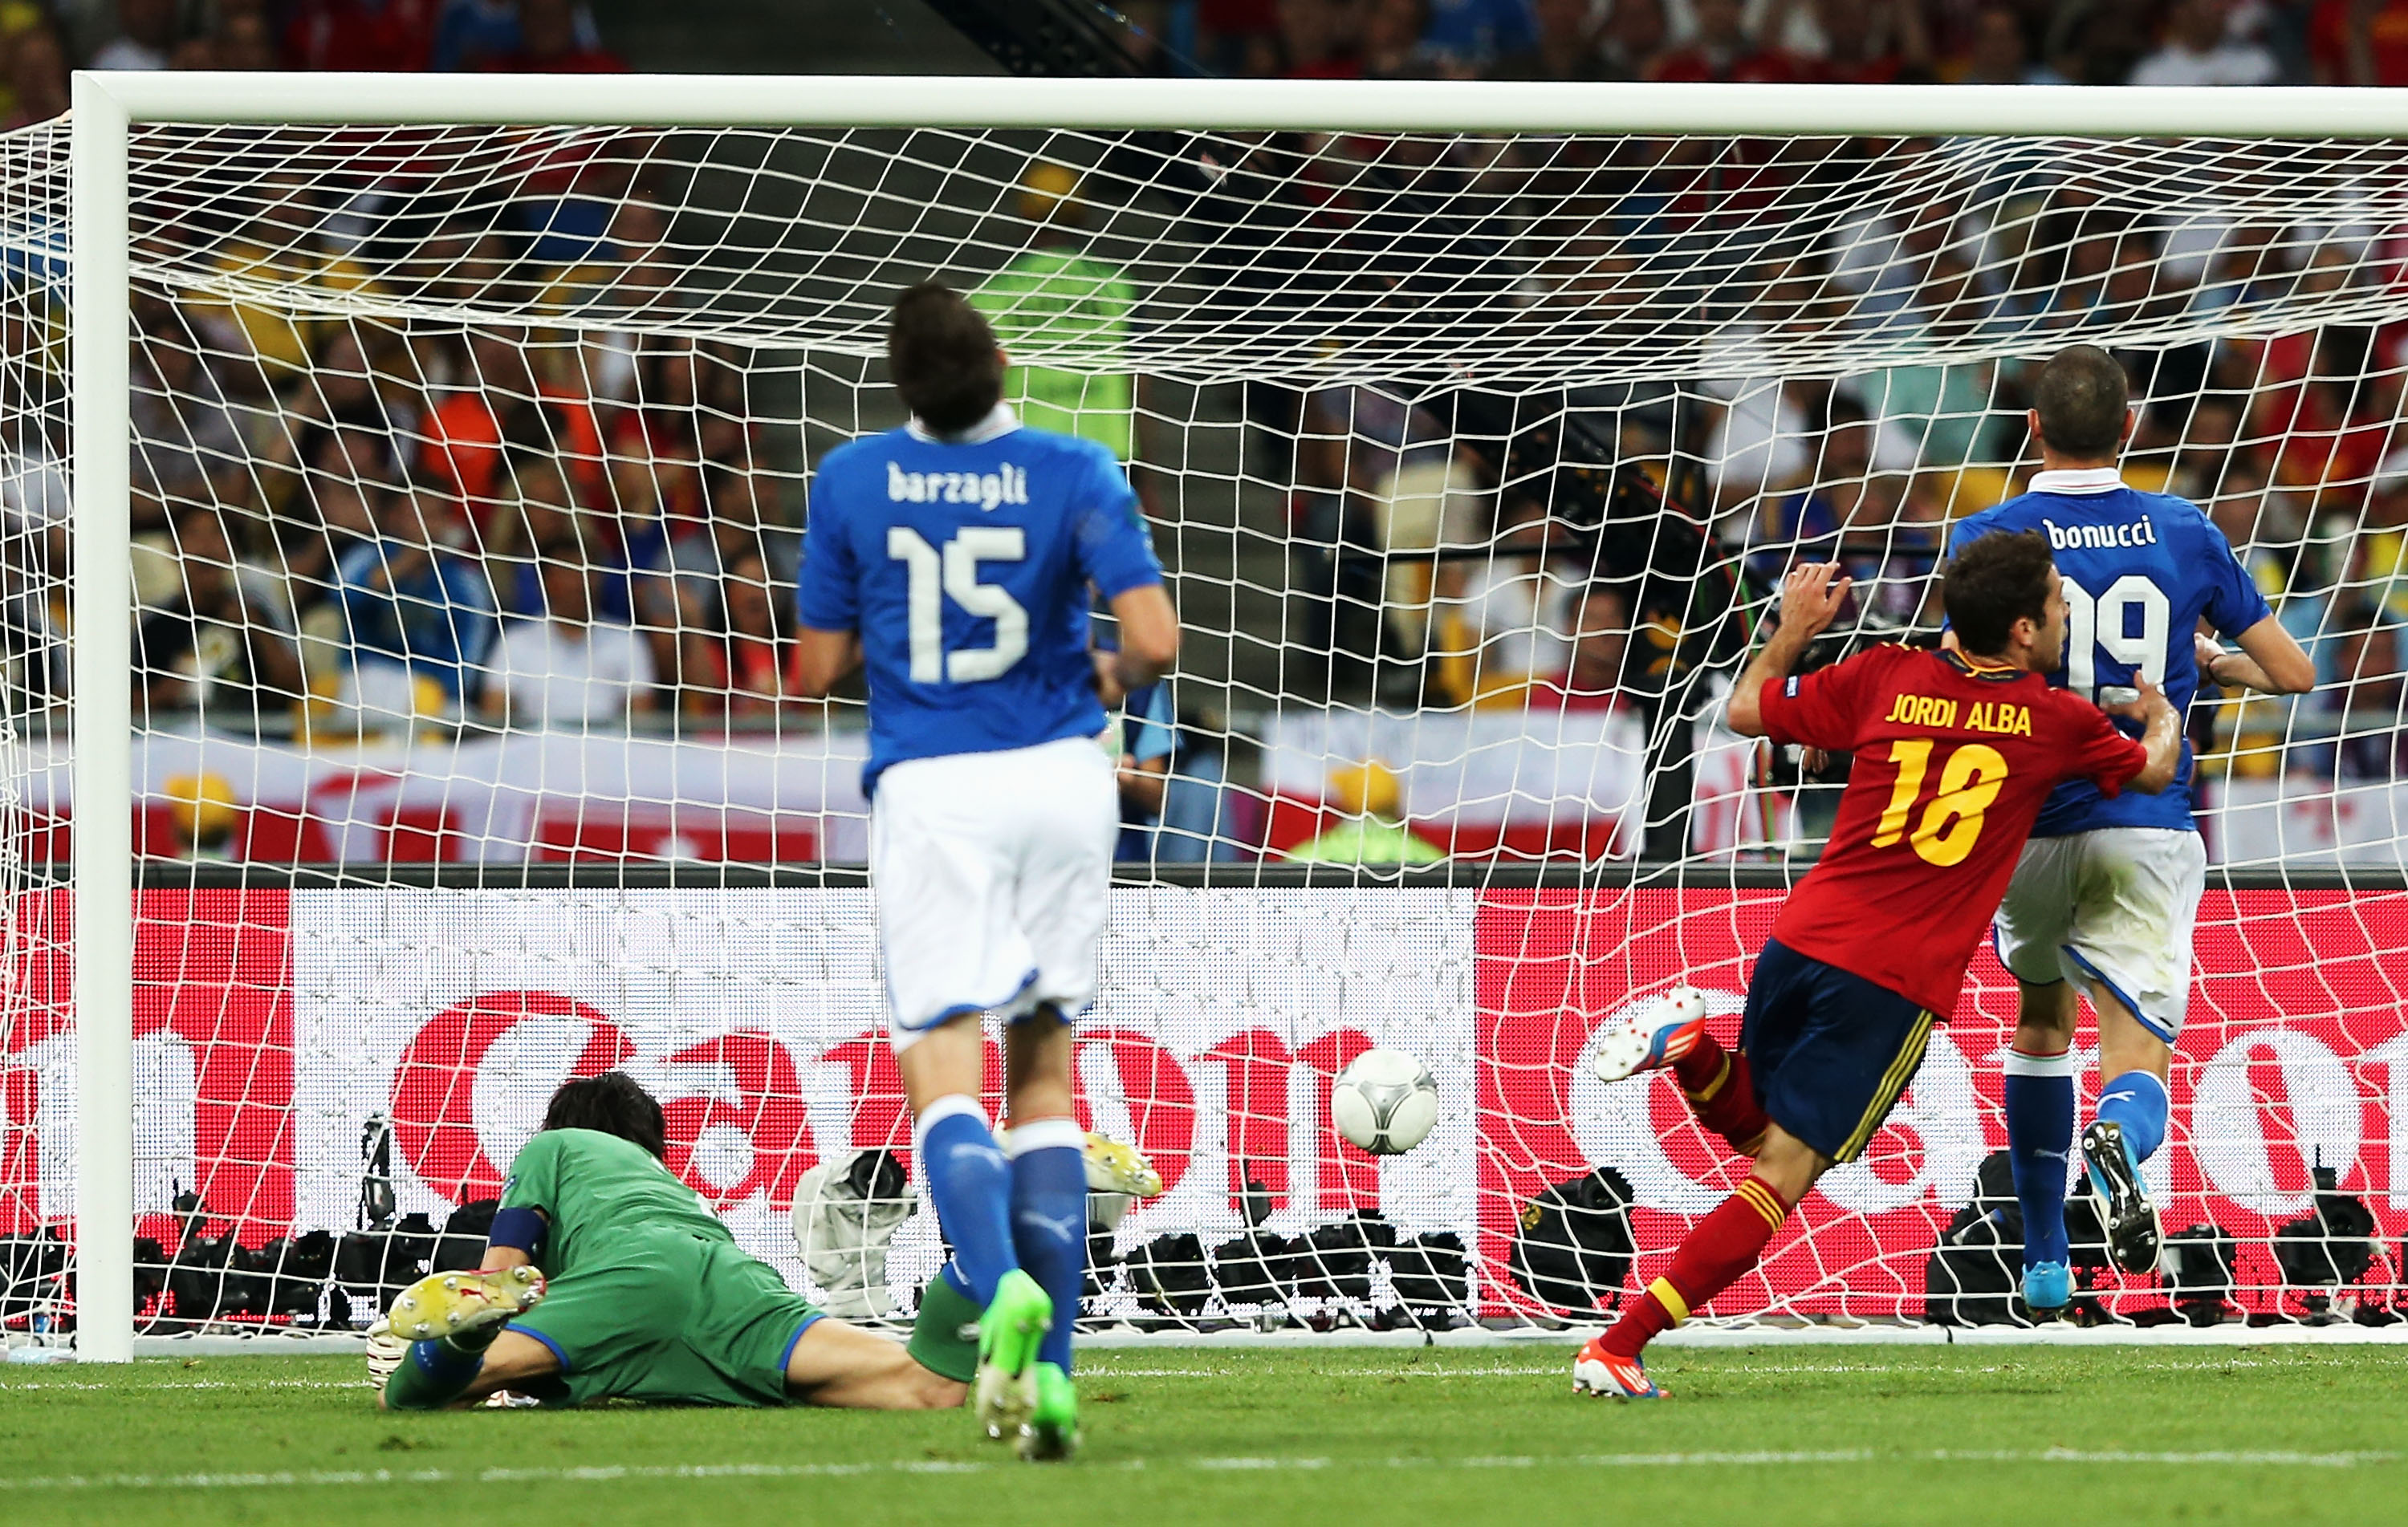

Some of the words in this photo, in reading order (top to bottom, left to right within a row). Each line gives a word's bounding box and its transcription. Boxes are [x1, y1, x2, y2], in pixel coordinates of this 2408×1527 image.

[887, 461, 1028, 512] barzagli
[2042, 514, 2157, 550] bonucci
[887, 526, 1028, 683] 15
[2060, 575, 2170, 705] 19
[1885, 693, 1958, 729] JORDI
[1964, 701, 2032, 737] ALBA
[1870, 737, 2009, 867] 18
[1568, 988, 2408, 1215] Cao
